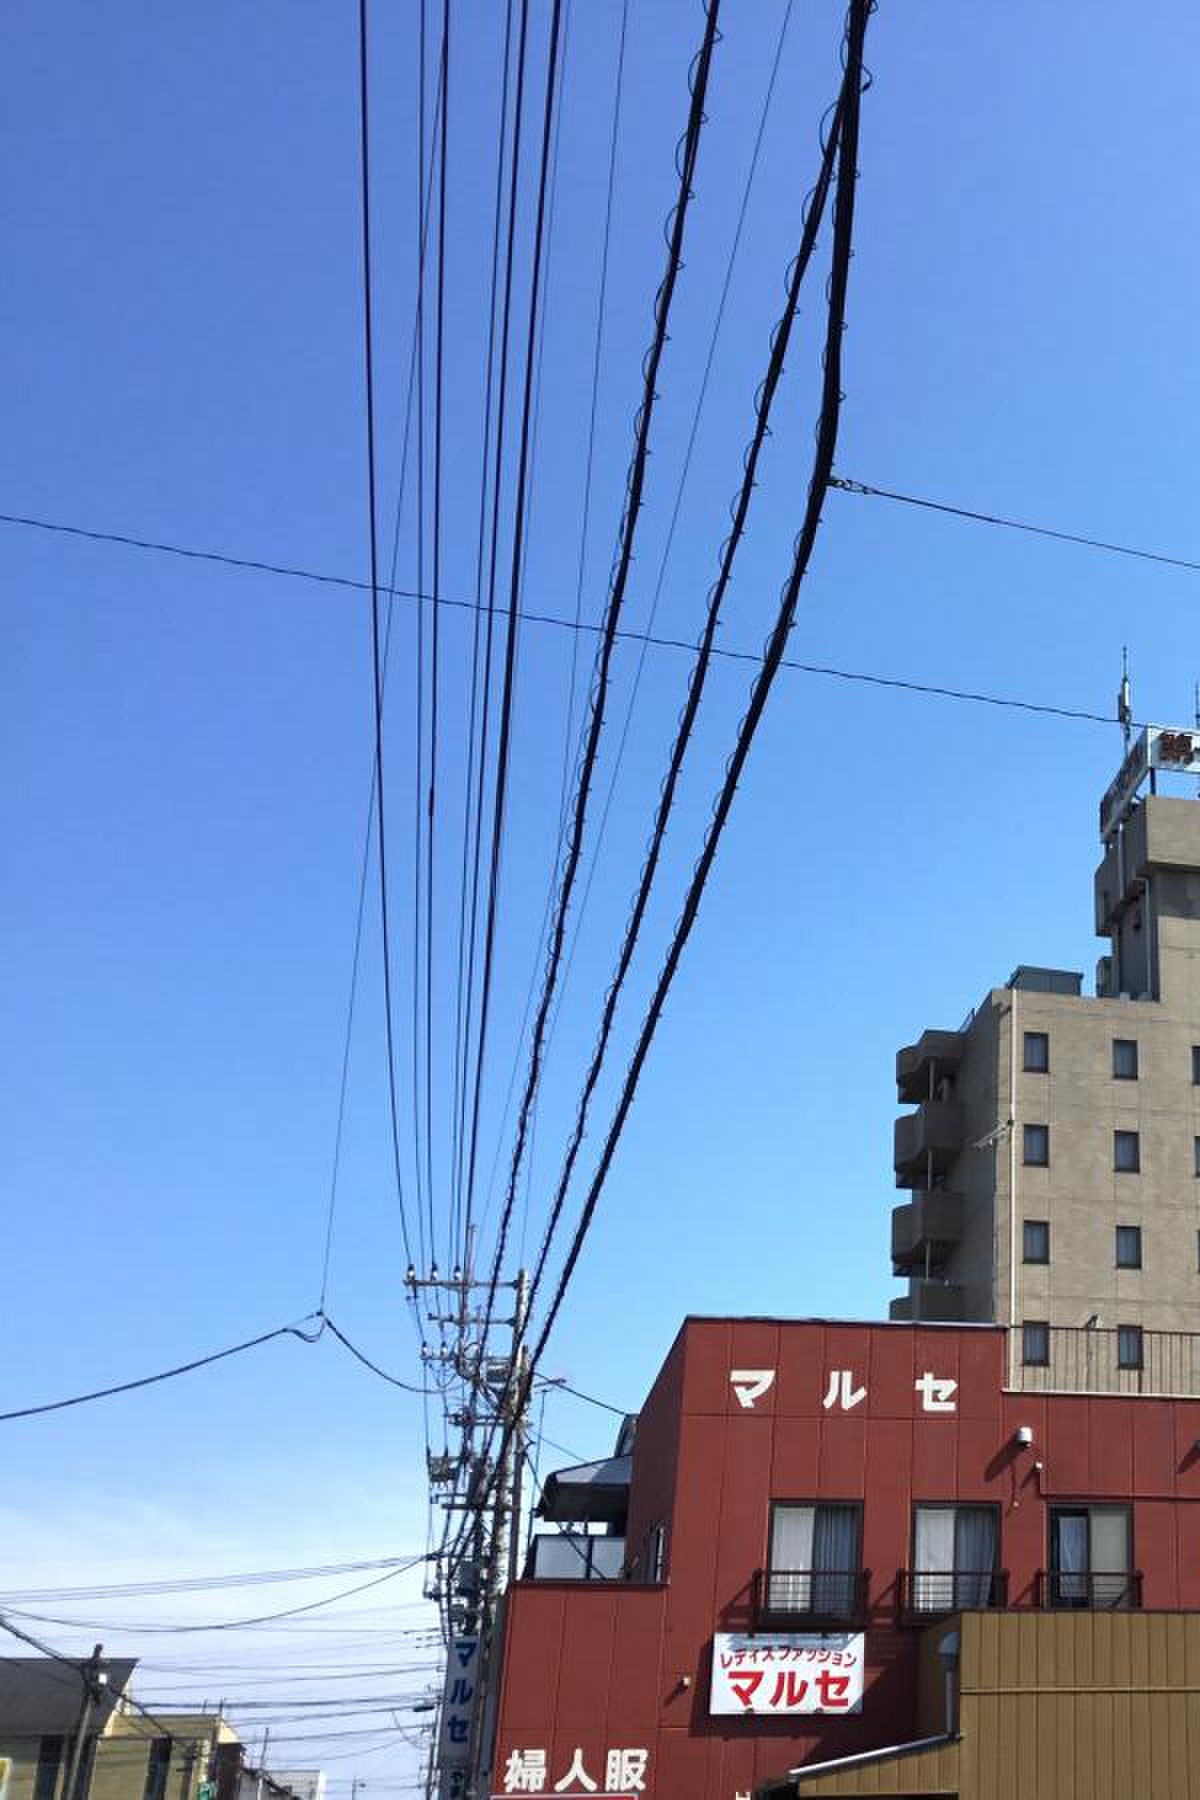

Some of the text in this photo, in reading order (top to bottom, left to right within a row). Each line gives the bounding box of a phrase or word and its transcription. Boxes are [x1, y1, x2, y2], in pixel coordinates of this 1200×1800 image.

[729, 1370, 958, 1411] マルセ
[448, 1641, 476, 1742] マルセ
[727, 1670, 851, 1707] マルセ
[504, 1748, 649, 1792] 婦人服
